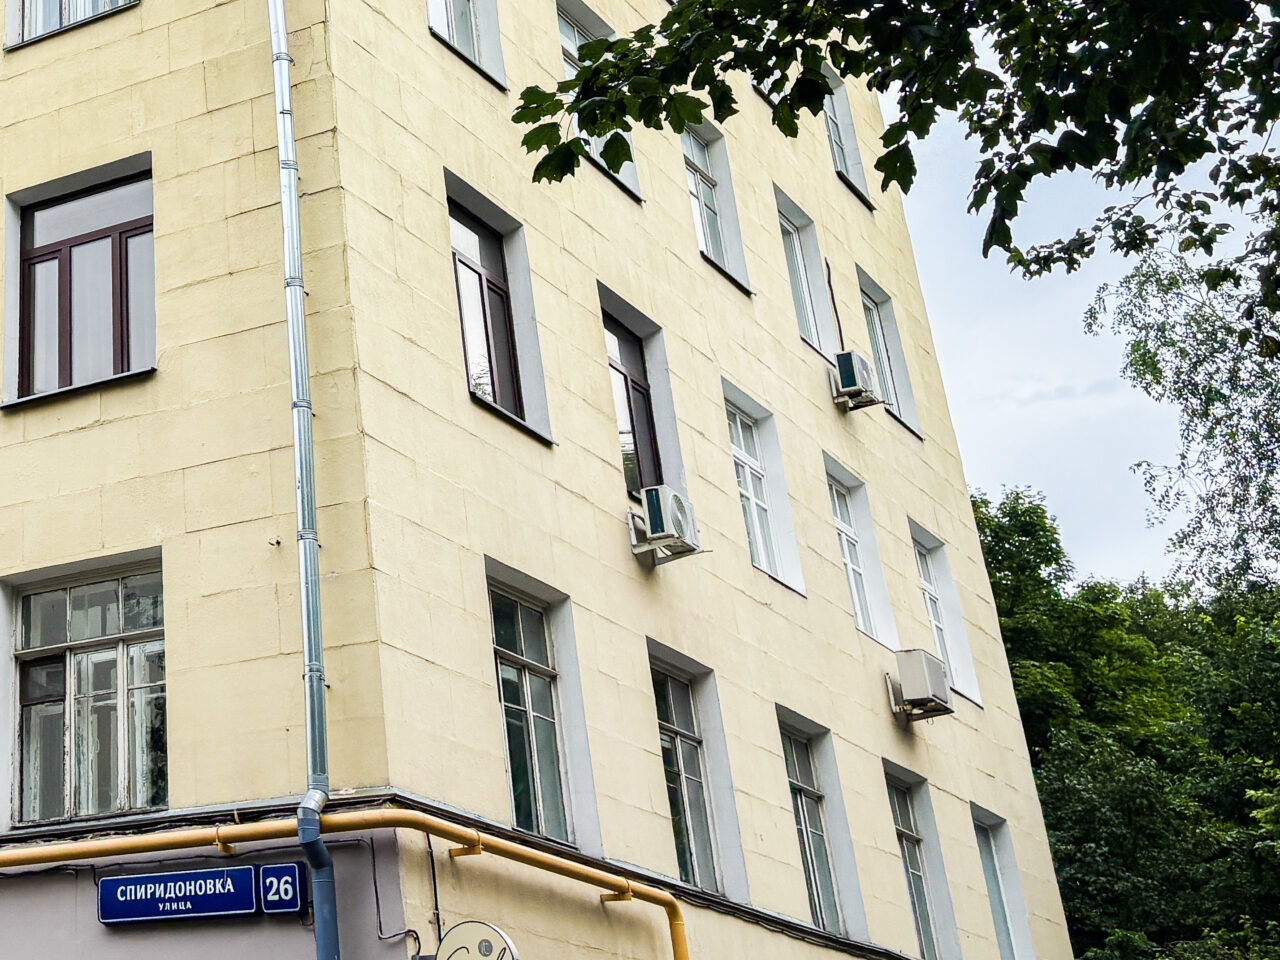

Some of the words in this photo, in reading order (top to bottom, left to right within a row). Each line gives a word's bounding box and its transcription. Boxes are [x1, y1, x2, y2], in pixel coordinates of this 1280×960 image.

[117, 878, 234, 901] СПИРИДОНОВКА
[265, 875, 294, 901] 26
[158, 901, 192, 911] УЛИЦА
